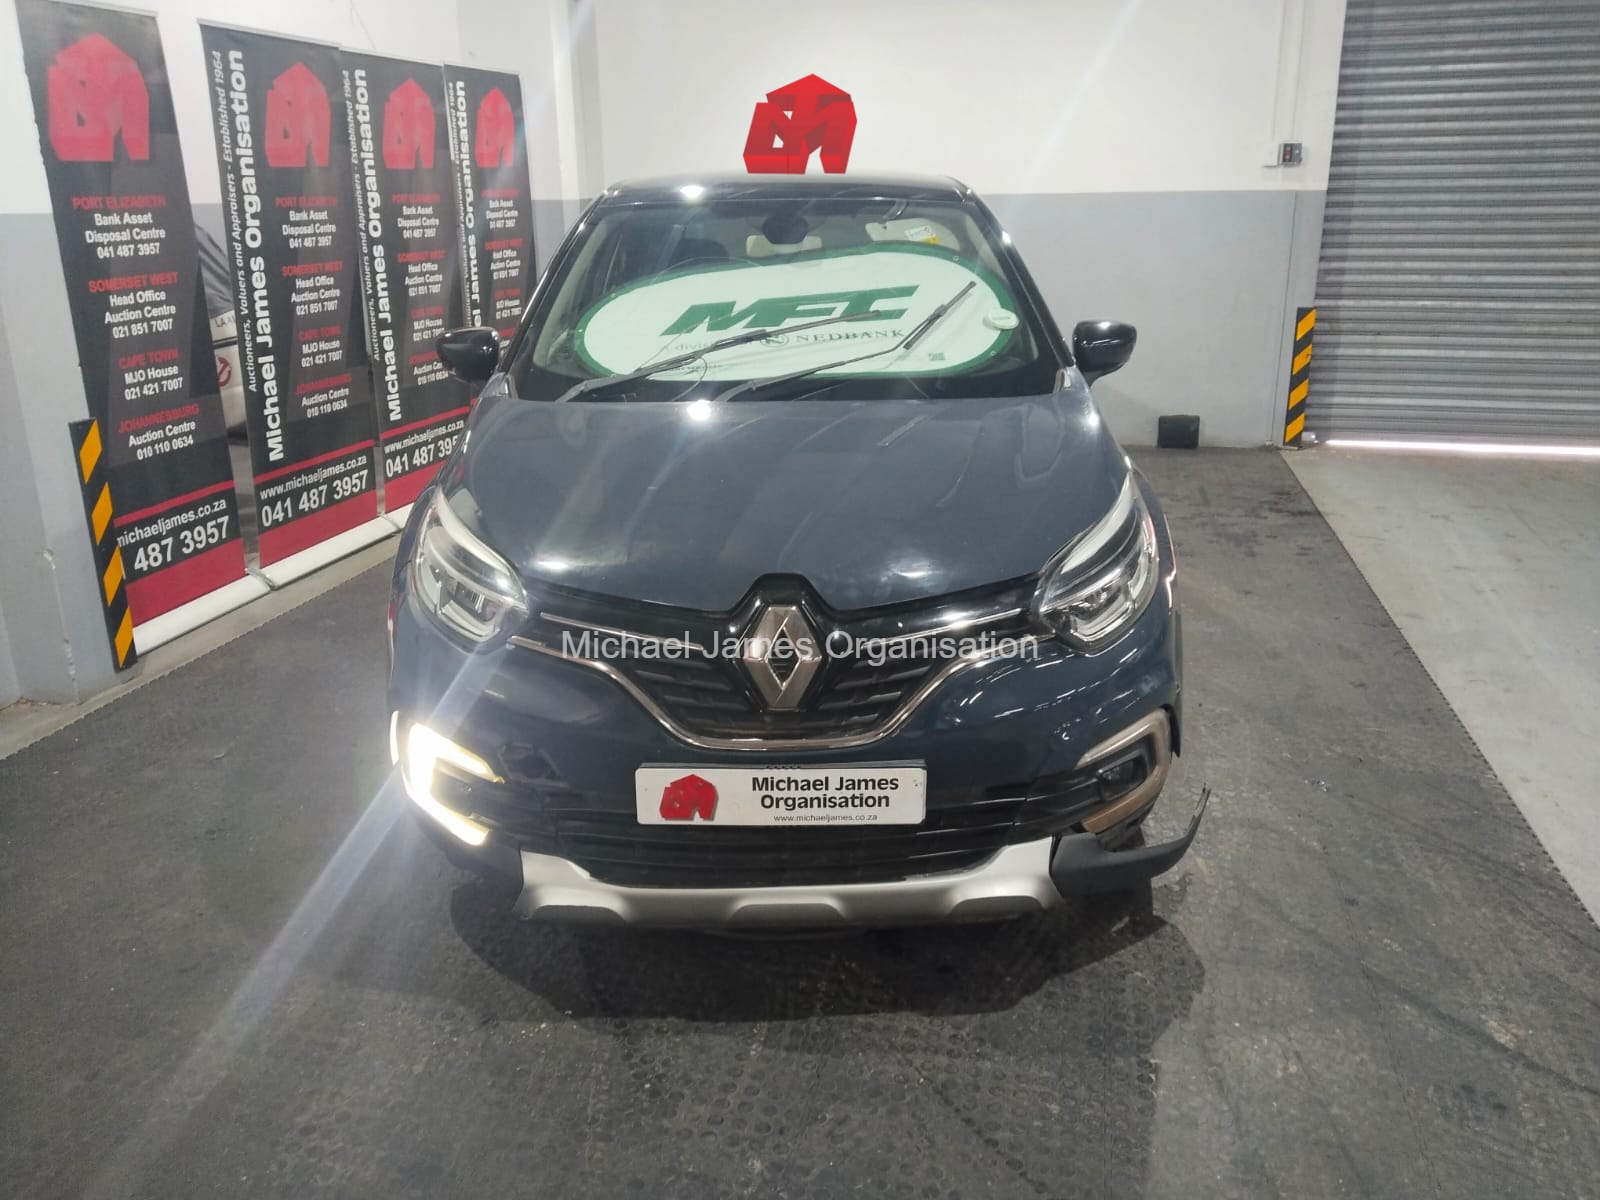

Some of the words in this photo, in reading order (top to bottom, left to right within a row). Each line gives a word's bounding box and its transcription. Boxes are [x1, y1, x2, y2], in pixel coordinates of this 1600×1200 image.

[212, 50, 224, 84] 1964
[215, 86, 233, 163] Established
[228, 50, 262, 249] Organisation
[354, 69, 382, 238] Organisation
[456, 80, 475, 229] Organisation
[94, 213, 121, 226] Bank
[123, 212, 153, 225] Asset
[227, 172, 242, 240] Appraisers
[289, 210, 308, 221] Bank
[309, 210, 328, 220] Asset
[85, 228, 131, 245] Disposal
[132, 227, 166, 241] Centre
[282, 223, 314, 237] Disposal
[315, 223, 336, 234] Centre
[97, 246, 115, 259] 041
[116, 245, 135, 257] 487
[137, 242, 160, 256] 3957
[232, 241, 243, 267] and
[315, 275, 334, 287] Office
[467, 234, 480, 304] James
[237, 269, 249, 315] Valuers
[291, 291, 319, 303] Auction
[372, 244, 391, 324] James
[109, 292, 135, 307] Head
[136, 289, 166, 303] Office
[250, 256, 273, 348] James
[660, 284, 920, 336] MFC
[105, 308, 142, 324] Auction
[144, 305, 176, 318] Centre
[113, 326, 130, 339] 021
[131, 322, 149, 336] 851
[151, 318, 173, 333] 7007
[797, 329, 906, 343] NEDBANK
[243, 319, 257, 392] Auctioneers,
[319, 339, 340, 352] House
[124, 369, 146, 385] MJO
[147, 365, 179, 380] House
[124, 386, 141, 401] 021
[142, 382, 160, 397] 421
[161, 376, 184, 392] 7007
[380, 329, 402, 422] Michael
[258, 354, 284, 462] Michael
[302, 392, 328, 407] Auction
[128, 428, 164, 448] Auction
[165, 420, 196, 437] Centre
[136, 446, 153, 461] 010
[154, 440, 170, 455] 110
[172, 434, 194, 450] 0634
[384, 420, 464, 454] www.michaeljames.co.za
[386, 453, 408, 478] 041
[412, 444, 435, 467] 487
[437, 435, 459, 458] 39
[260, 455, 367, 500] www.michaeljames.co.za
[262, 497, 292, 528] 041
[298, 484, 328, 513] 487
[332, 469, 369, 501] 3957
[134, 537, 173, 572] 487
[180, 515, 229, 554] 3957
[752, 776, 829, 792] Michael
[835, 776, 899, 792] James
[760, 792, 890, 812] Organisation
[773, 813, 877, 824] www.michaeljames.co.za
